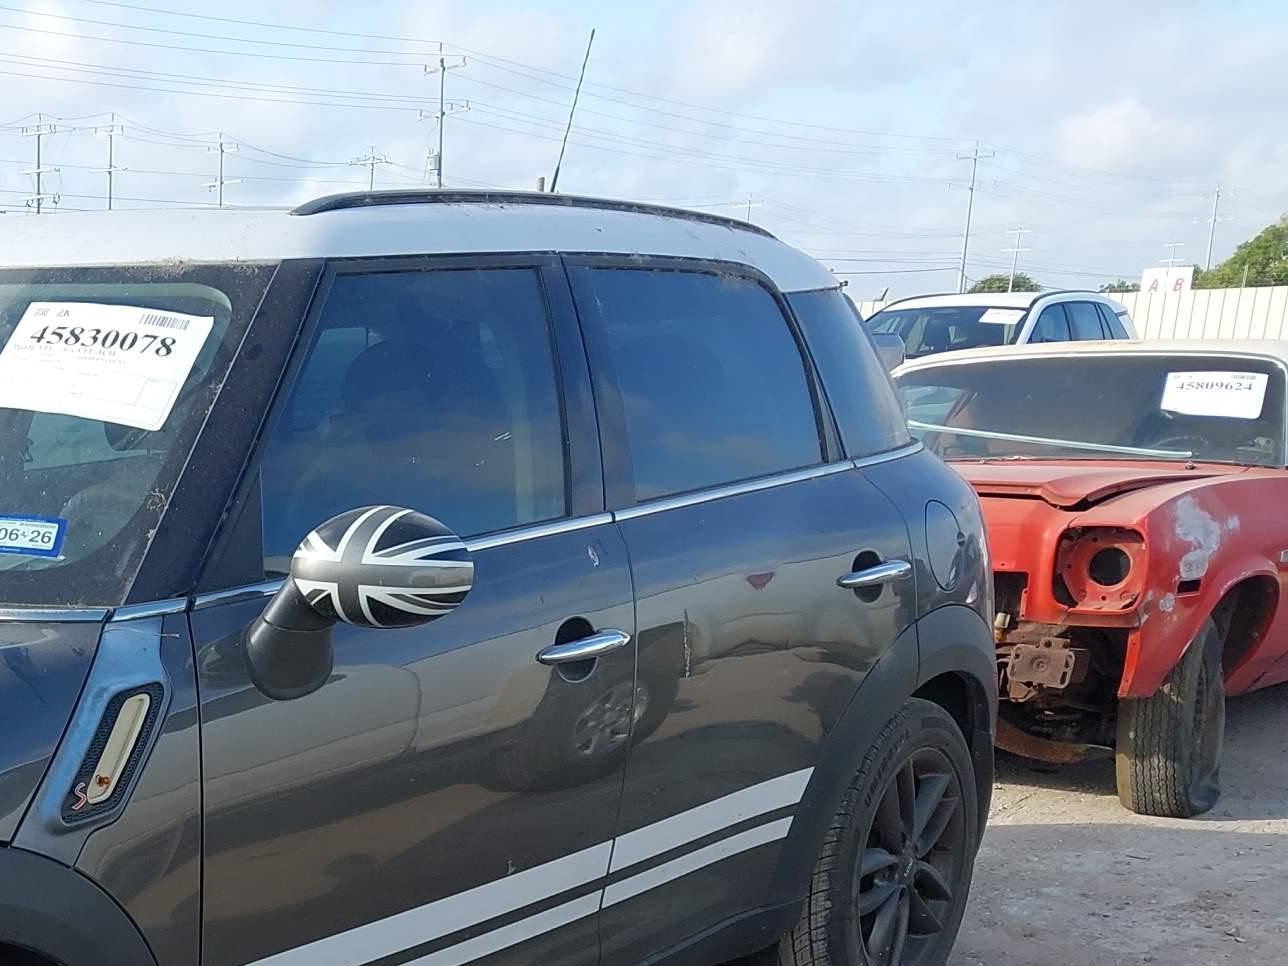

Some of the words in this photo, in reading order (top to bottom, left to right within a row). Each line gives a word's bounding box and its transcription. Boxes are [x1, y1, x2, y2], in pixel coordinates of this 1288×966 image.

[1148, 278, 1158, 291] A
[1173, 278, 1184, 291] B
[30, 325, 177, 357] 45830078
[1175, 382, 1253, 391] 45809624
[28, 530, 52, 544] 26
